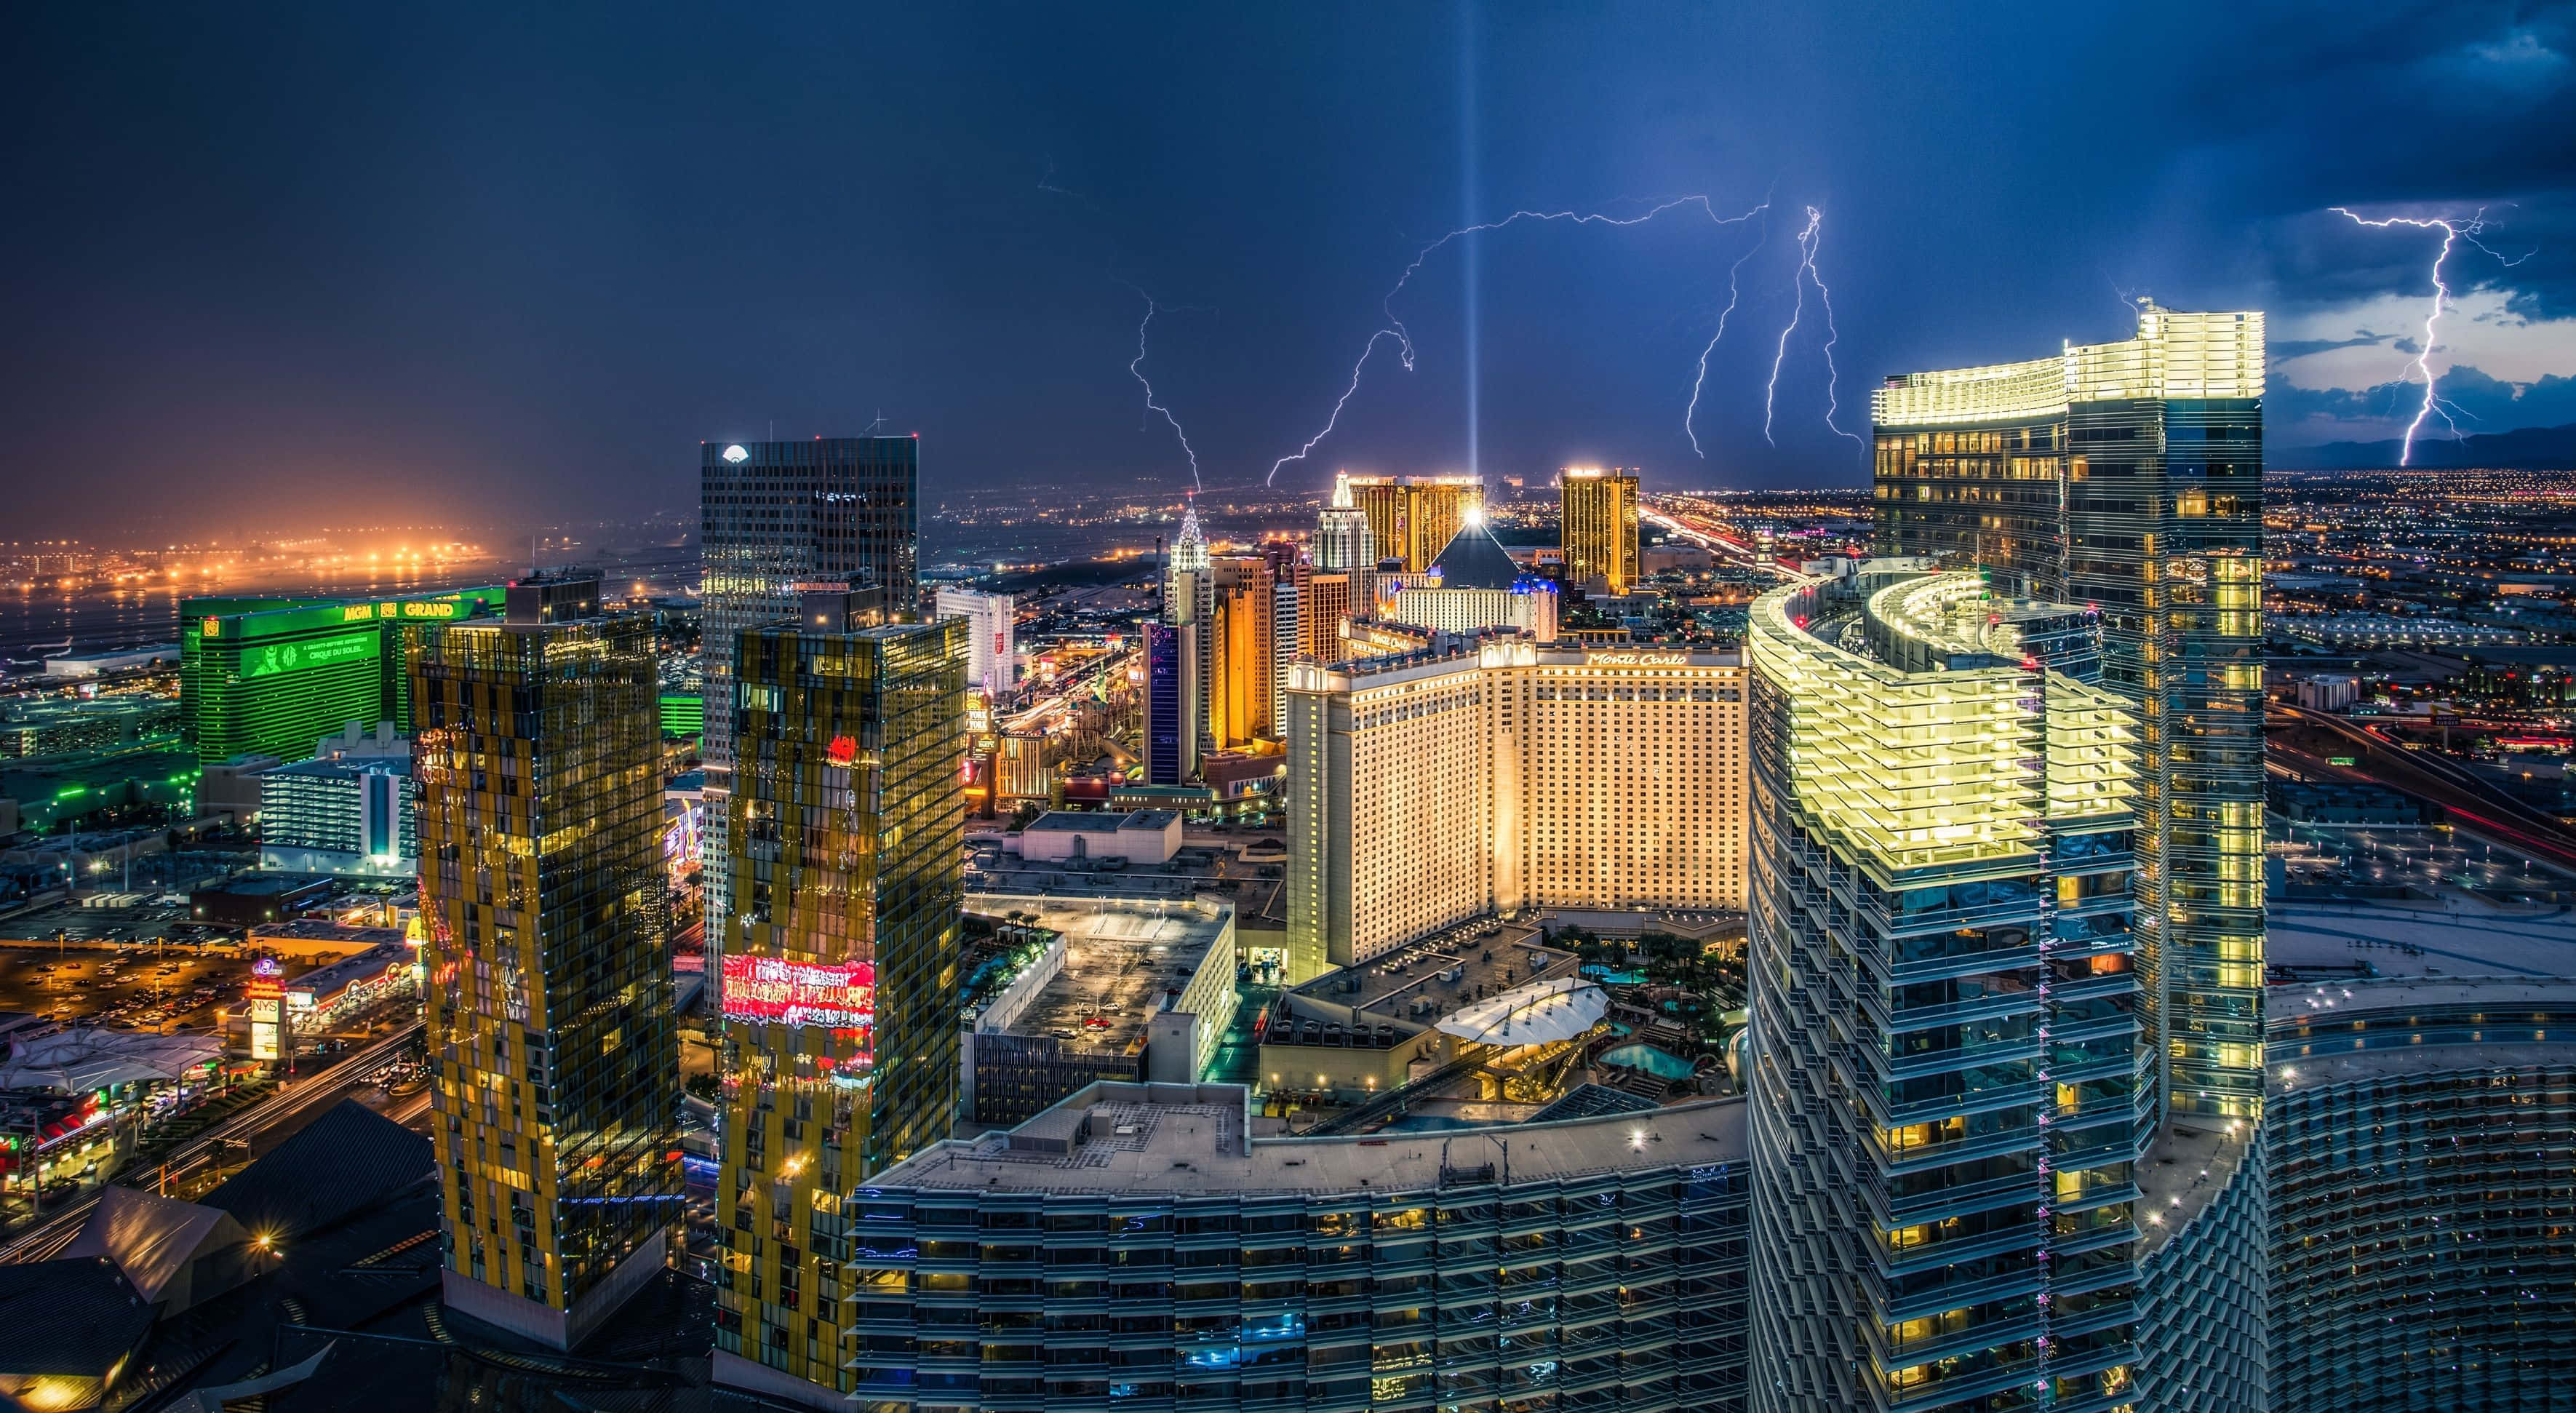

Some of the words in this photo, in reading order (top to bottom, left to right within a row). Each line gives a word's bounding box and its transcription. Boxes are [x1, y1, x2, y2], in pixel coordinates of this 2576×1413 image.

[344, 605, 372, 621] MGM
[404, 603, 454, 617] GRAND
[309, 649, 332, 659] CIRQUE
[332, 648, 342, 656] DU
[1587, 653, 1638, 665] Monte
[1639, 653, 1687, 665] Carlo
[970, 711, 987, 719] YORK
[970, 720, 987, 729] YORK
[252, 1000, 278, 1012] NYS
